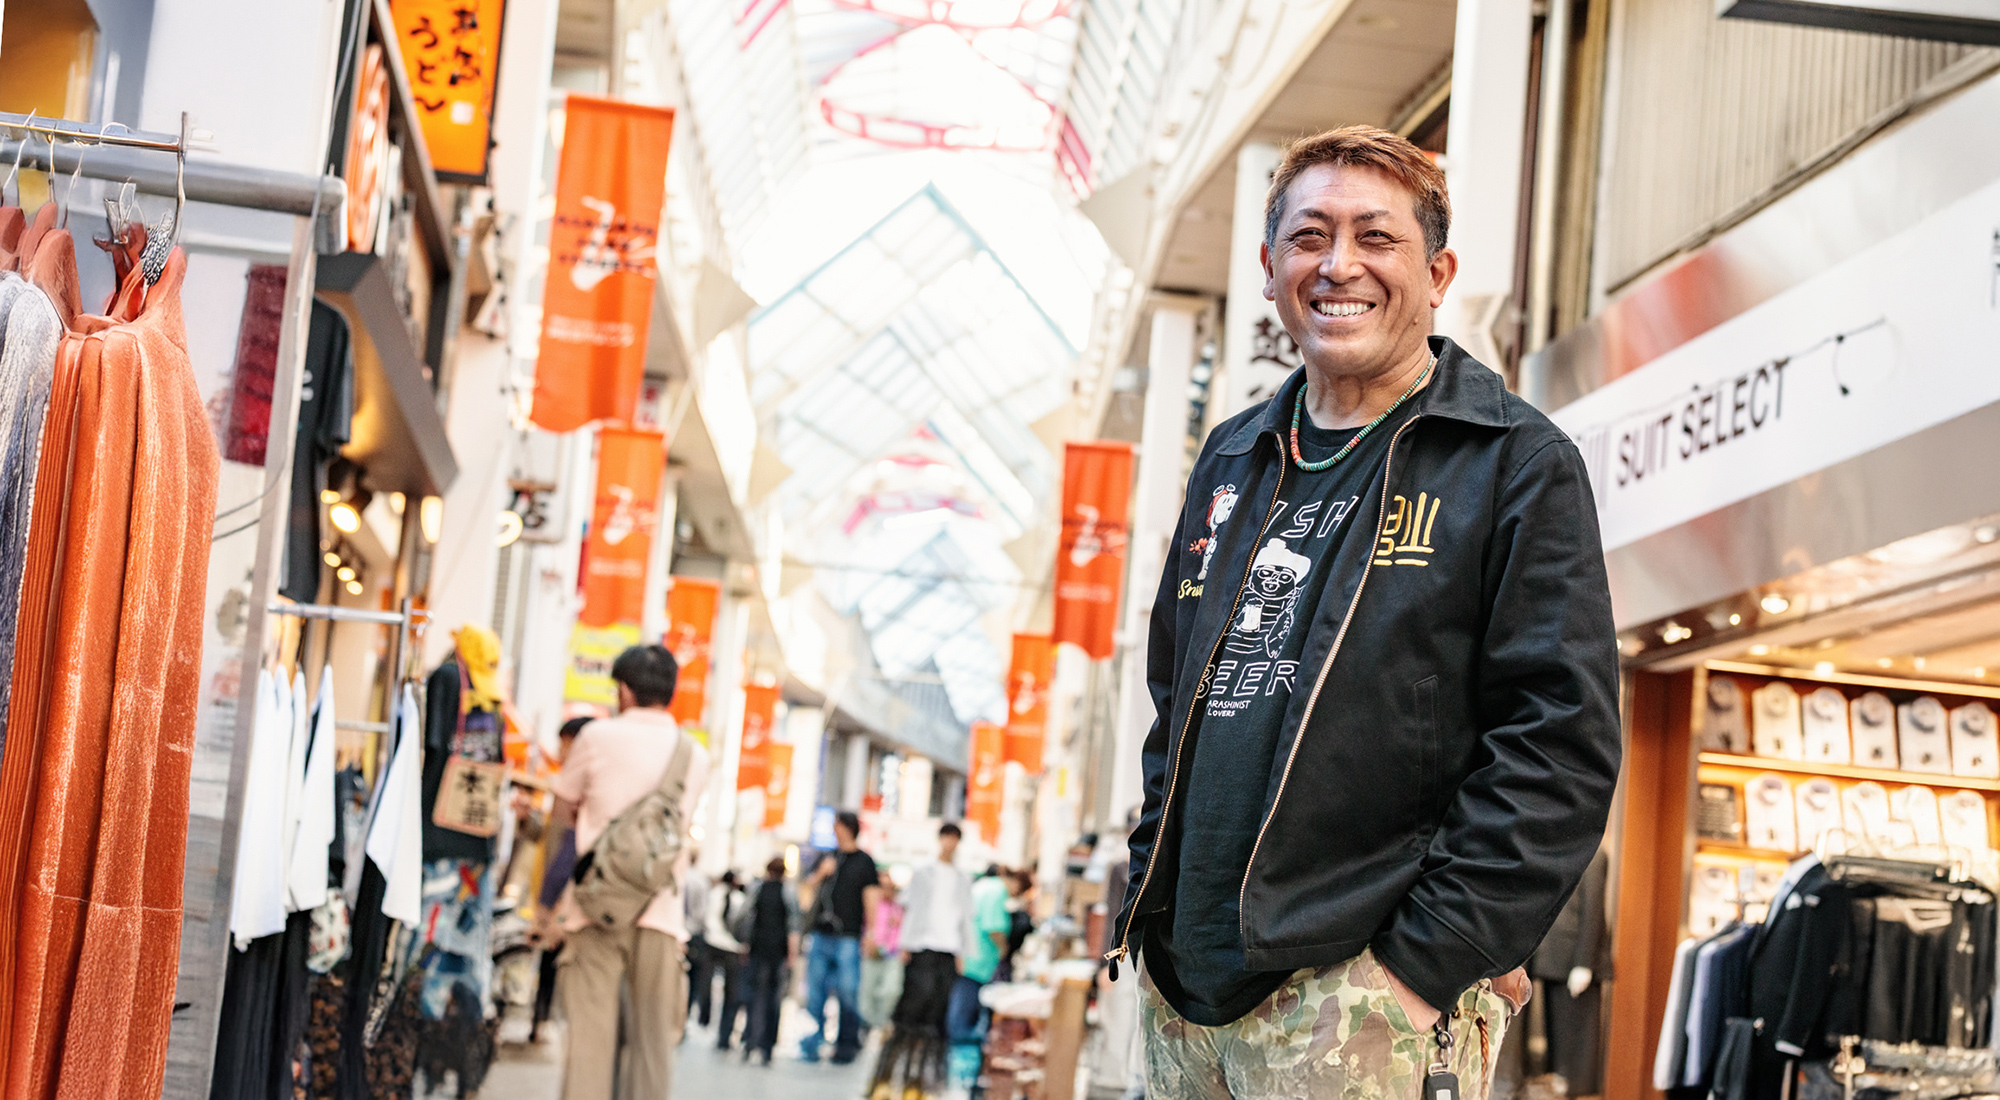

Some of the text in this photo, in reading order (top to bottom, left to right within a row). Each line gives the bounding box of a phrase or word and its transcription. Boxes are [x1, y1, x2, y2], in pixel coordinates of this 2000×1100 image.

[1615, 358, 1790, 487] SUIT SELECT
[1263, 495, 1360, 538] ISH
[1197, 660, 1300, 699] BEER
[1207, 708, 1236, 717] LOVERS
